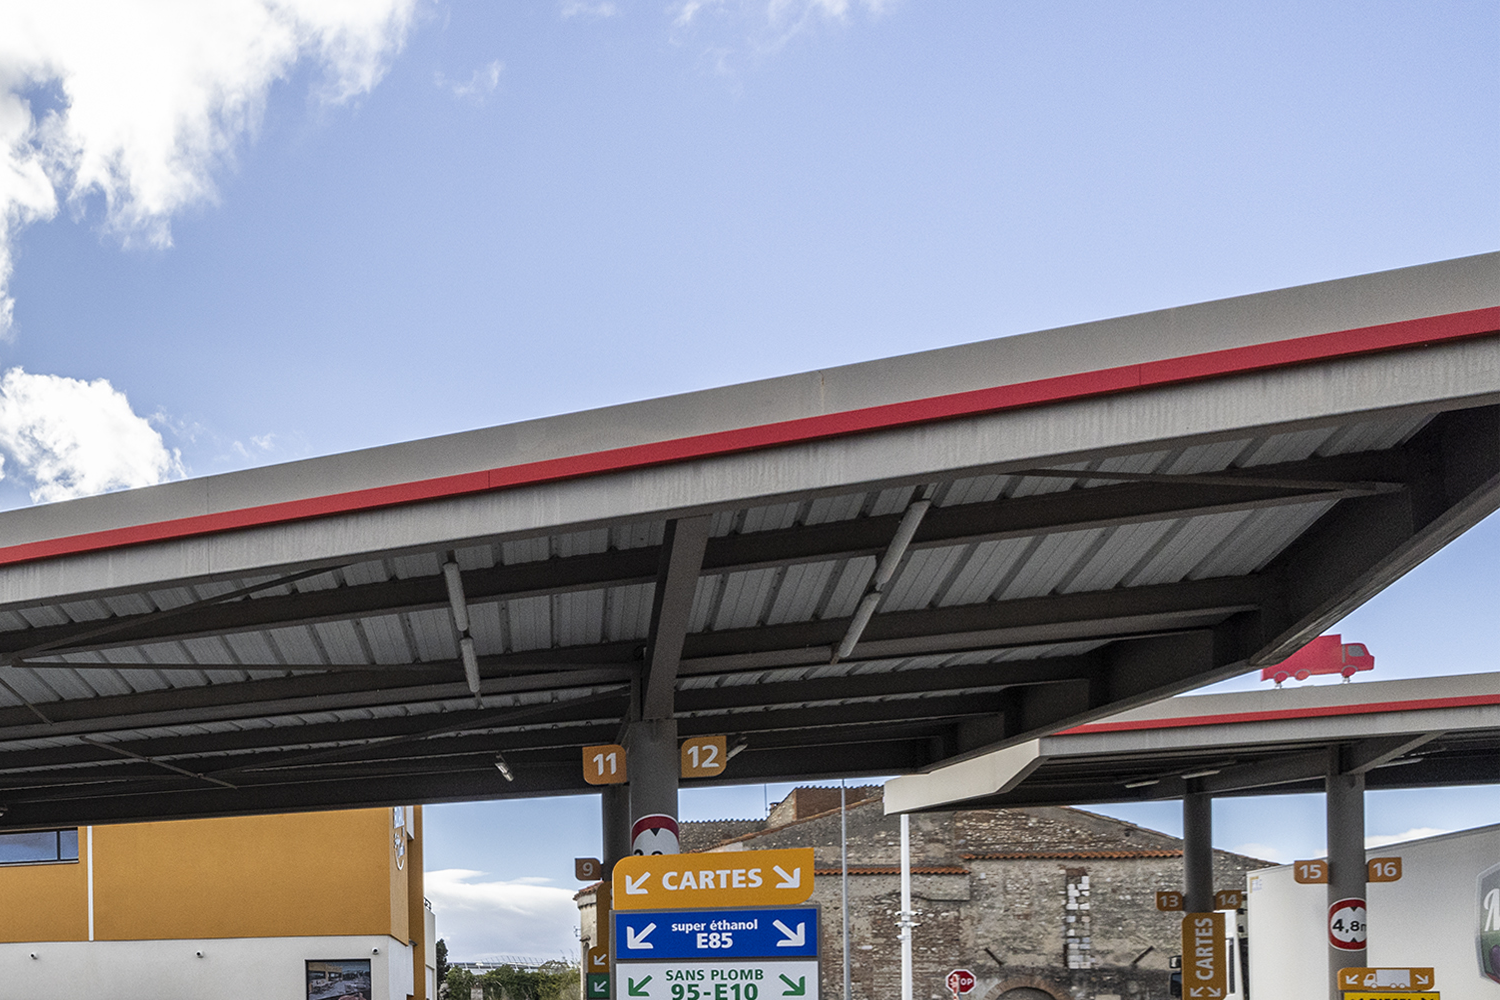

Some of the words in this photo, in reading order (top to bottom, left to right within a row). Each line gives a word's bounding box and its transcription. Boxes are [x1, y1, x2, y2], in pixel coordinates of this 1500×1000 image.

[593, 752, 617, 776] 11
[687, 745, 719, 768] 12
[582, 862, 594, 876] 9
[1299, 864, 1322, 879] 15
[1372, 862, 1397, 877] 16
[662, 868, 763, 891] CARTES
[1159, 895, 1179, 907] 13
[1218, 894, 1239, 906] 14
[671, 922, 706, 934] super
[709, 919, 758, 931] éthanol
[696, 932, 733, 949] E85
[1195, 917, 1214, 981] CARTES
[665, 970, 705, 981] SANS
[711, 969, 764, 981] PLOMB
[950, 977, 973, 986] OP
[671, 983, 759, 1000] 95-E10
